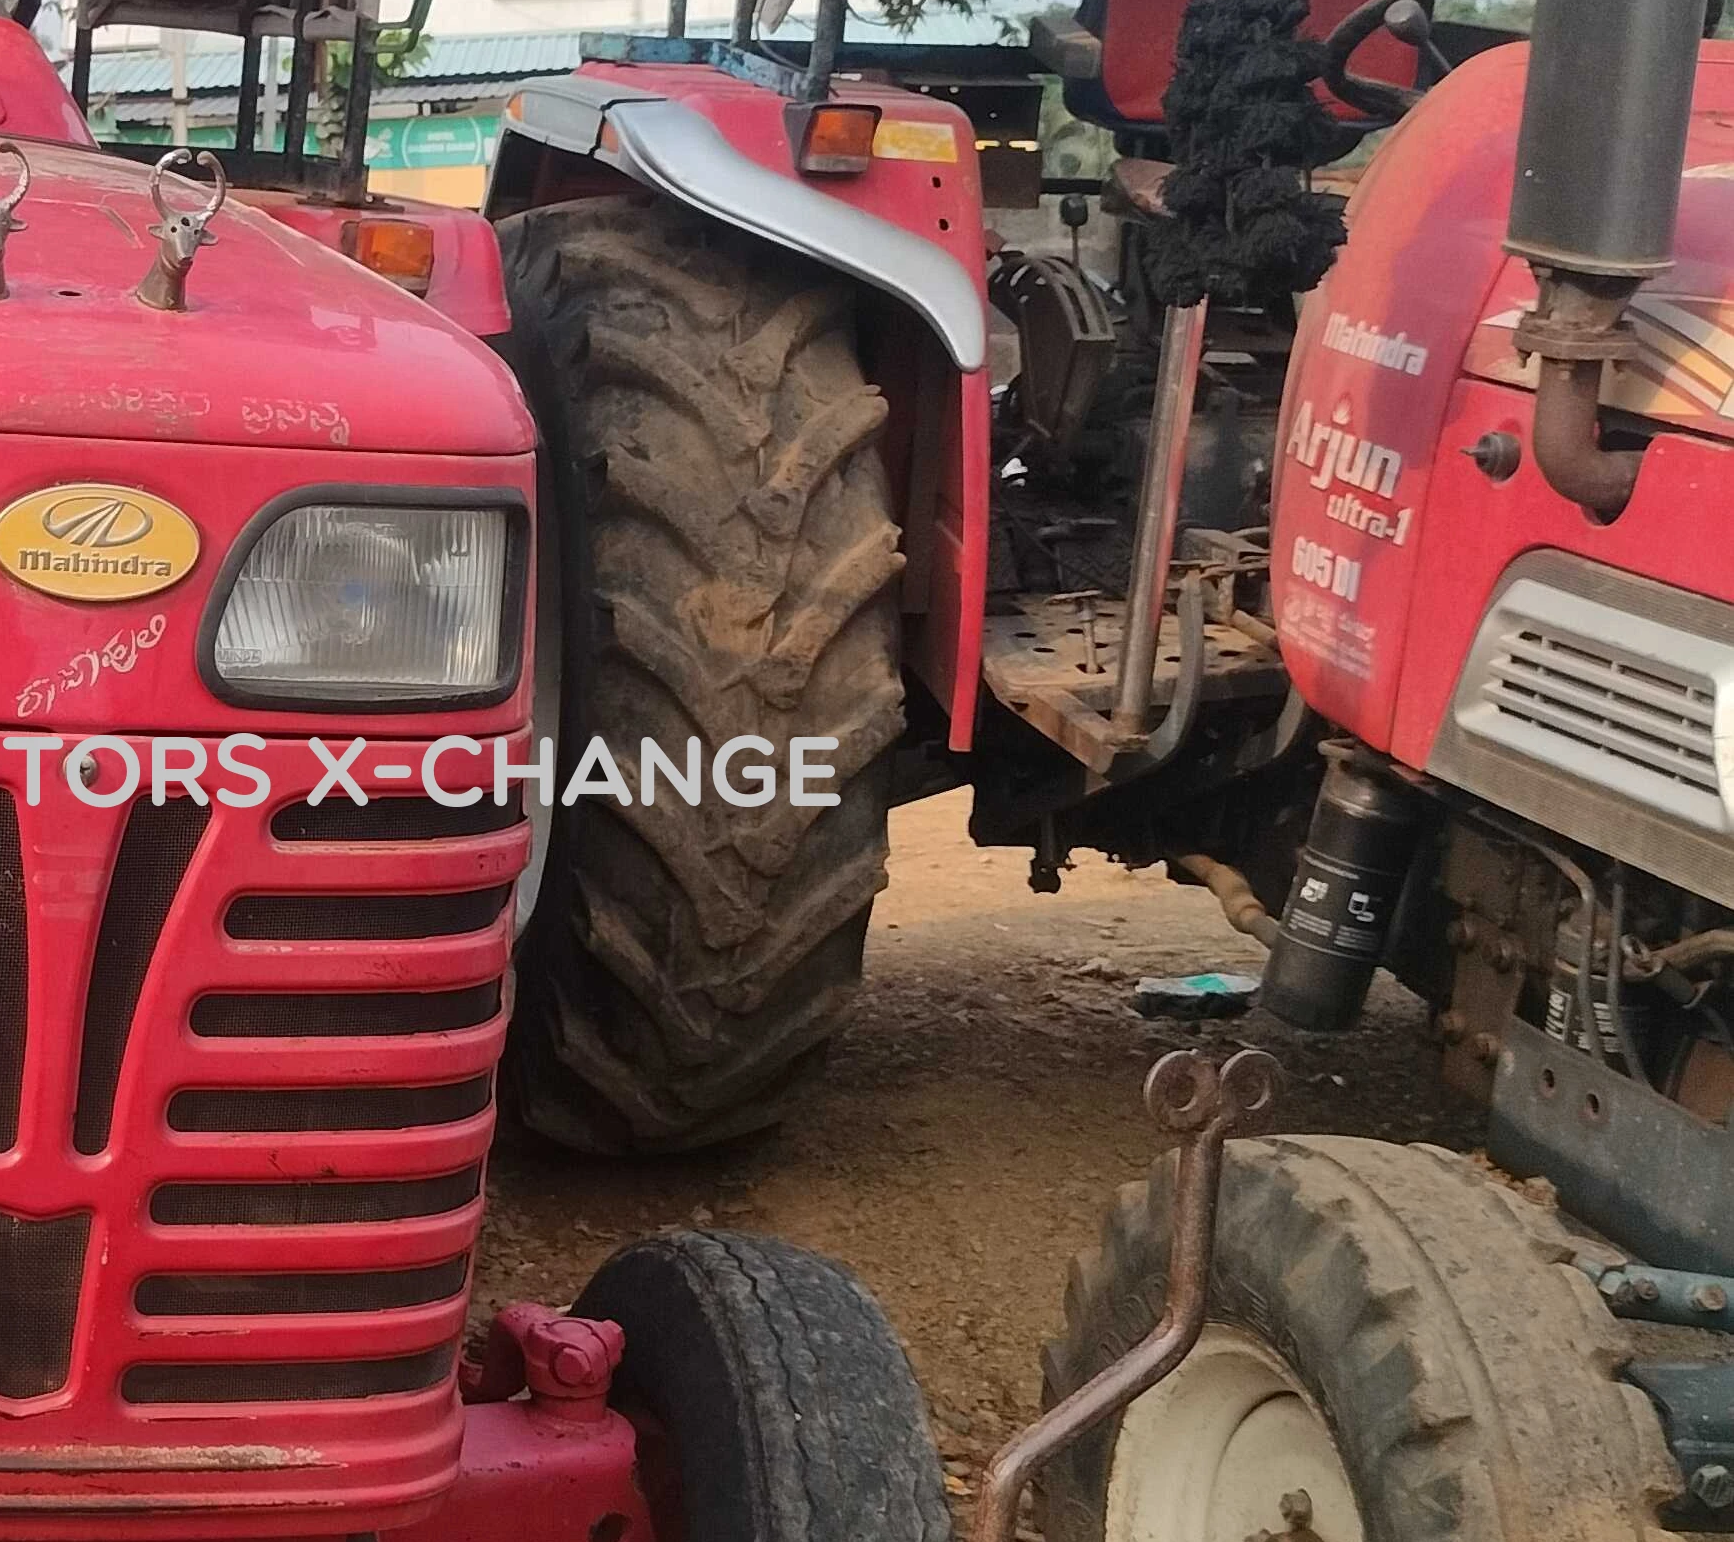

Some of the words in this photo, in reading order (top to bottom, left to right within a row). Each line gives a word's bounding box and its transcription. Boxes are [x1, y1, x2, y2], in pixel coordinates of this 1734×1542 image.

[1321, 311, 1429, 377] Mahindra
[1286, 398, 1402, 499] Arjun
[1325, 492, 1412, 546] ultra-1
[18, 548, 173, 578] Mahindra
